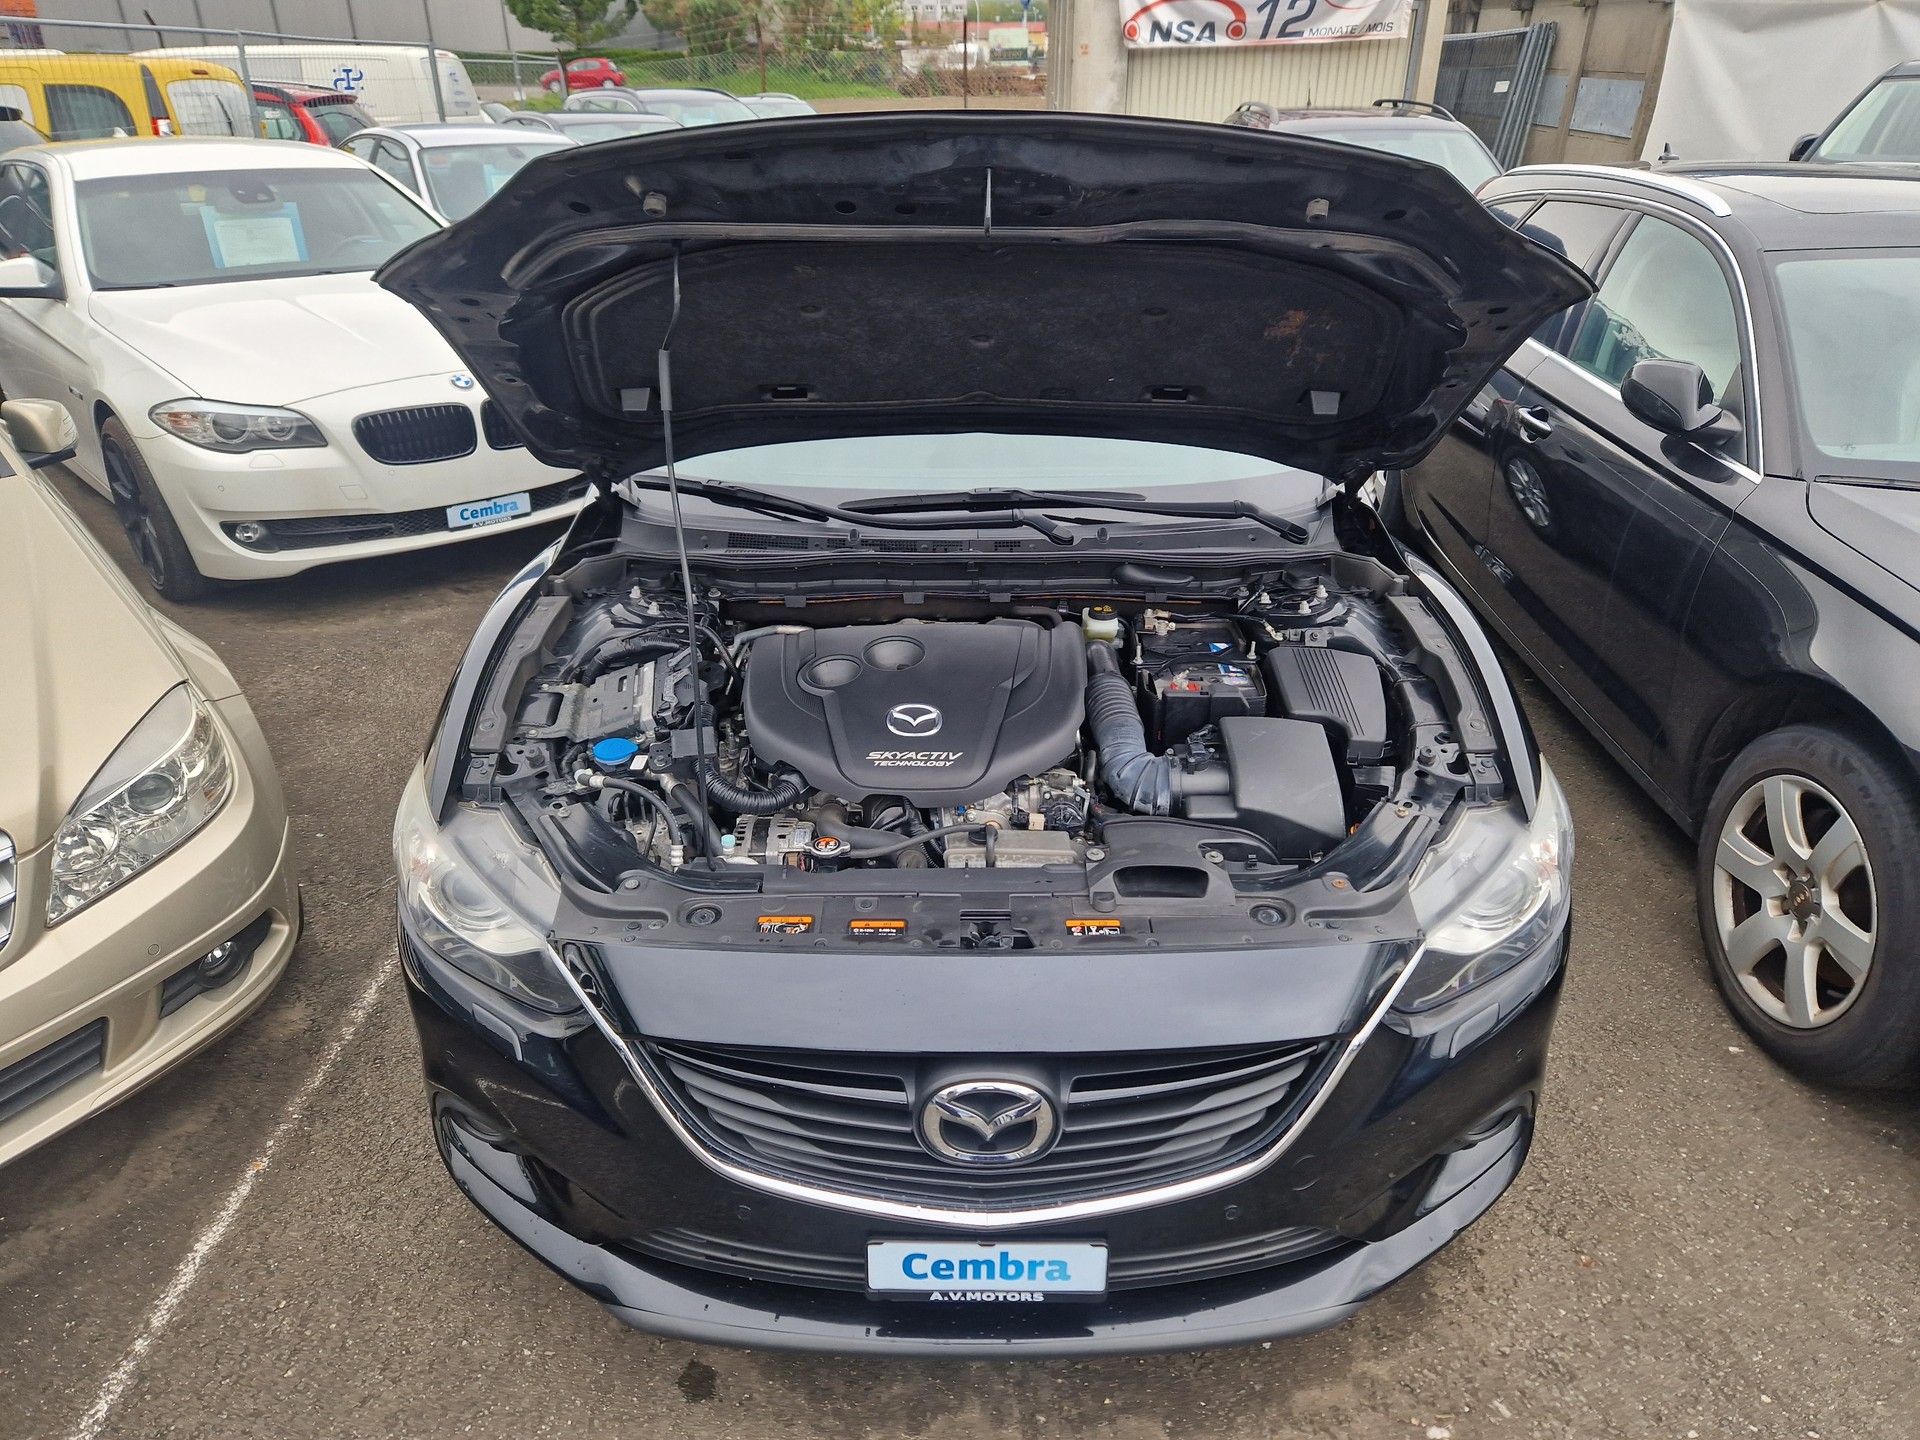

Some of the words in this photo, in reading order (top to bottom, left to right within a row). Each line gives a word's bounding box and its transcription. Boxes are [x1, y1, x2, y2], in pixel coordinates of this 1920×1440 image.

[1149, 20, 1217, 42] NSA
[1256, 0, 1318, 41] 12
[459, 500, 519, 521] Cembra
[865, 751, 964, 760] SKYACTIV
[901, 1251, 1072, 1282] Cembra
